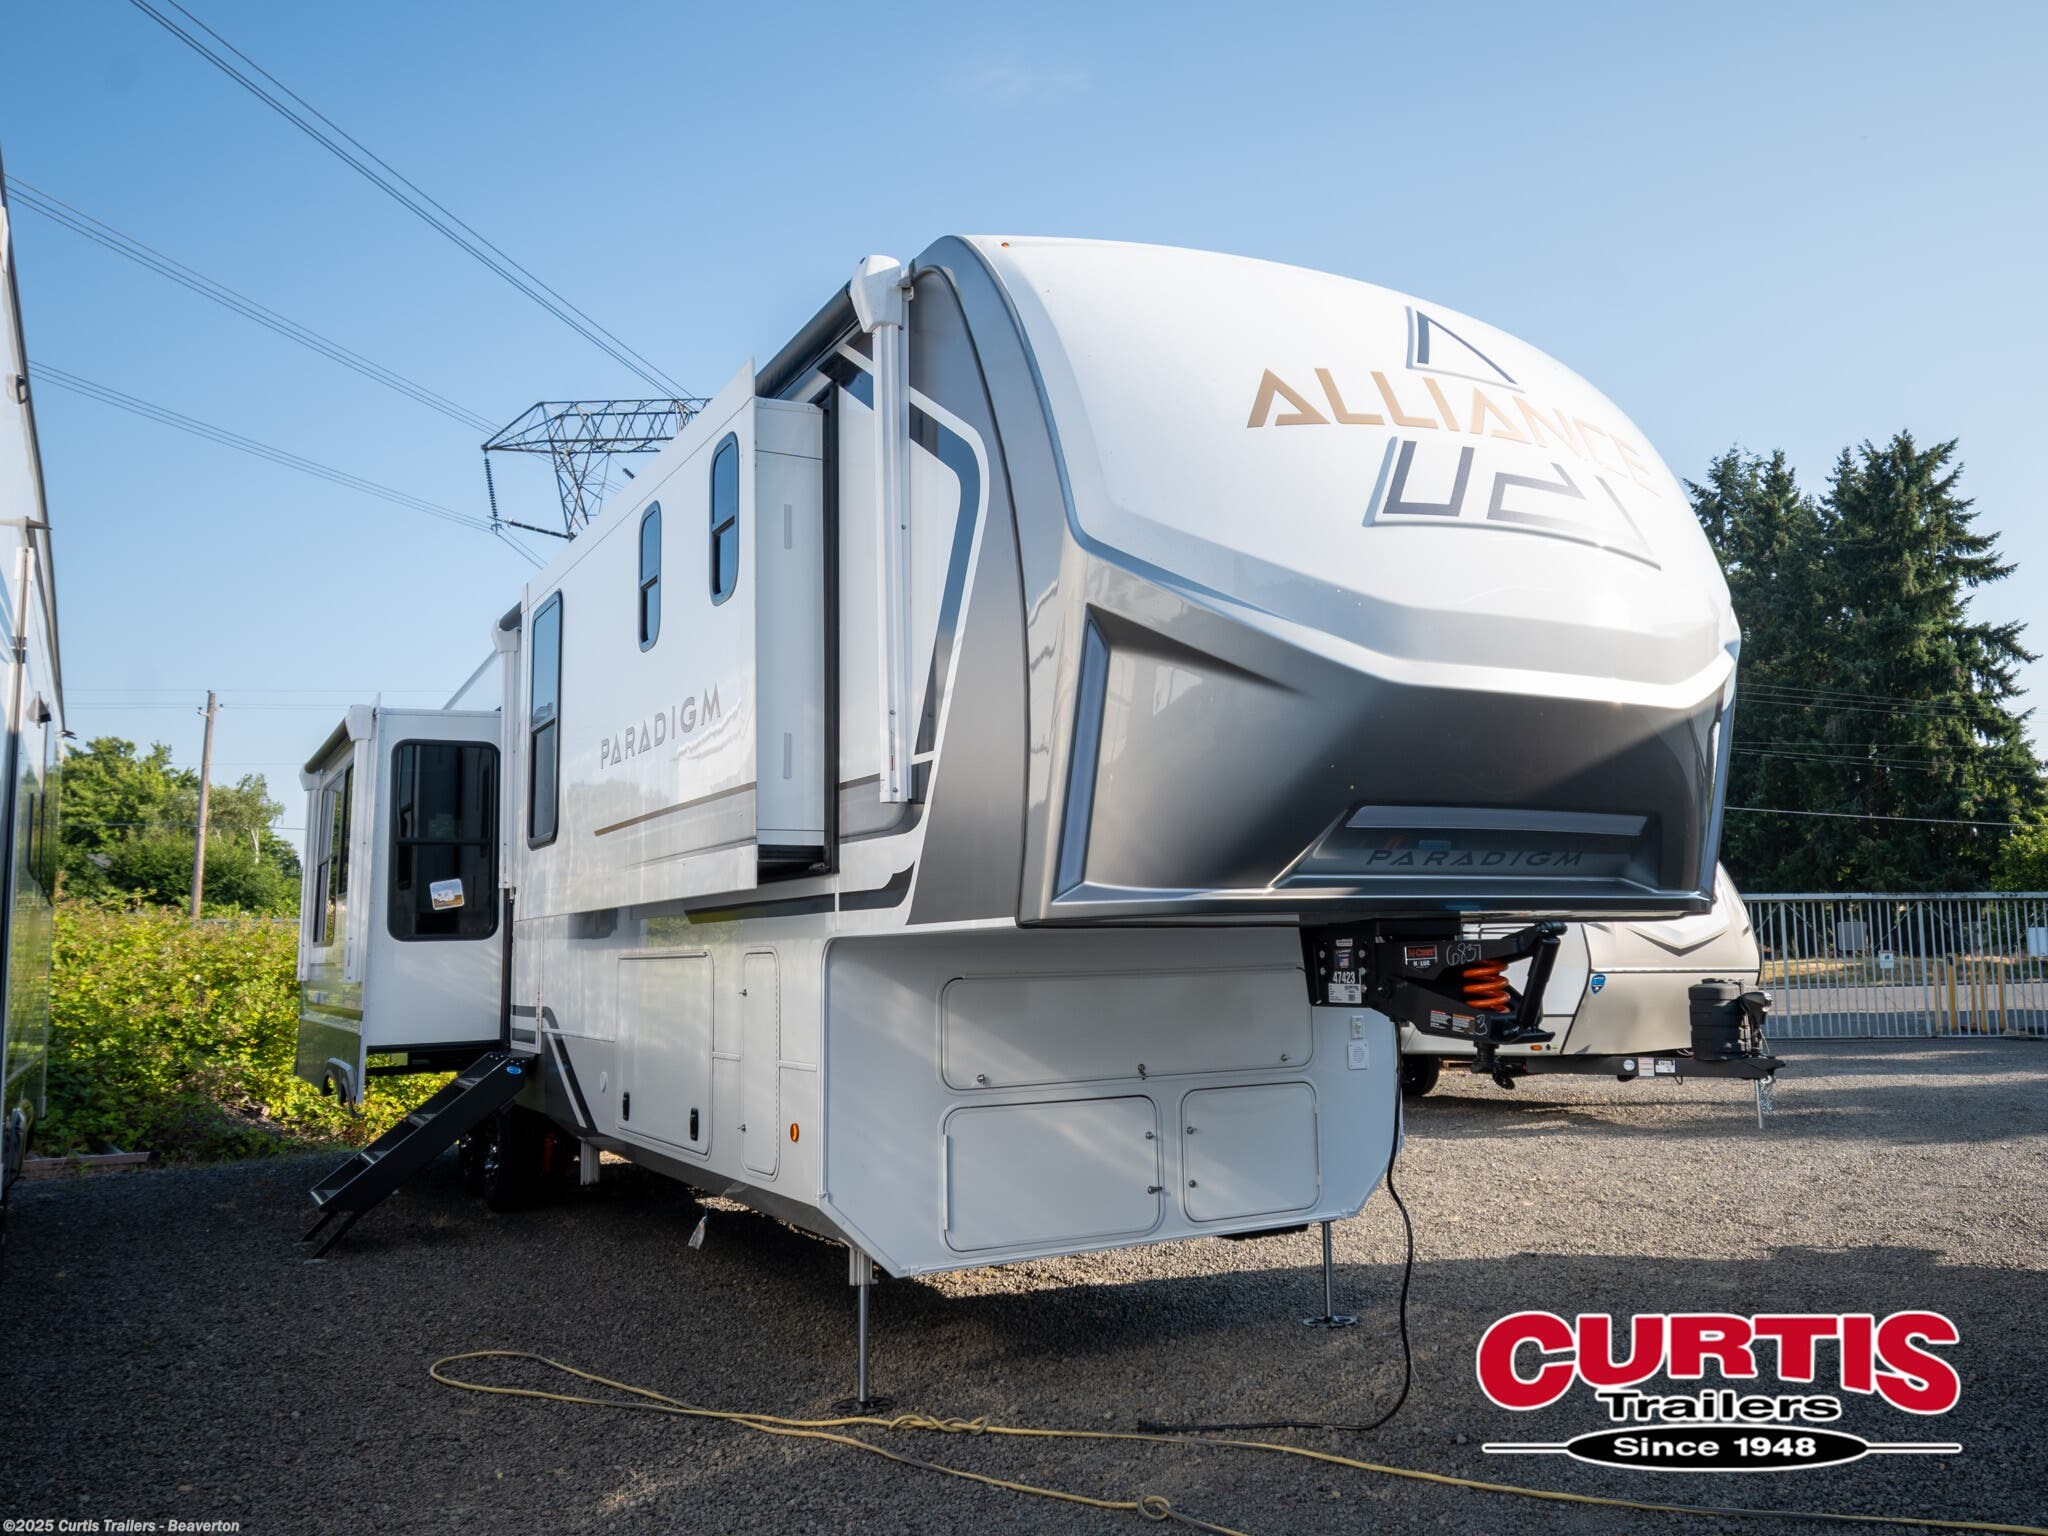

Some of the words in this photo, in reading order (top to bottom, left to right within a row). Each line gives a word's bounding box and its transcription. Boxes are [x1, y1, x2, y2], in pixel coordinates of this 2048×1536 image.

[1247, 367, 1663, 498] ALLIANCE
[600, 682, 721, 770] PARADIGM
[1366, 849, 1584, 868] PARADIGM
[1333, 971, 1356, 985] 47423
